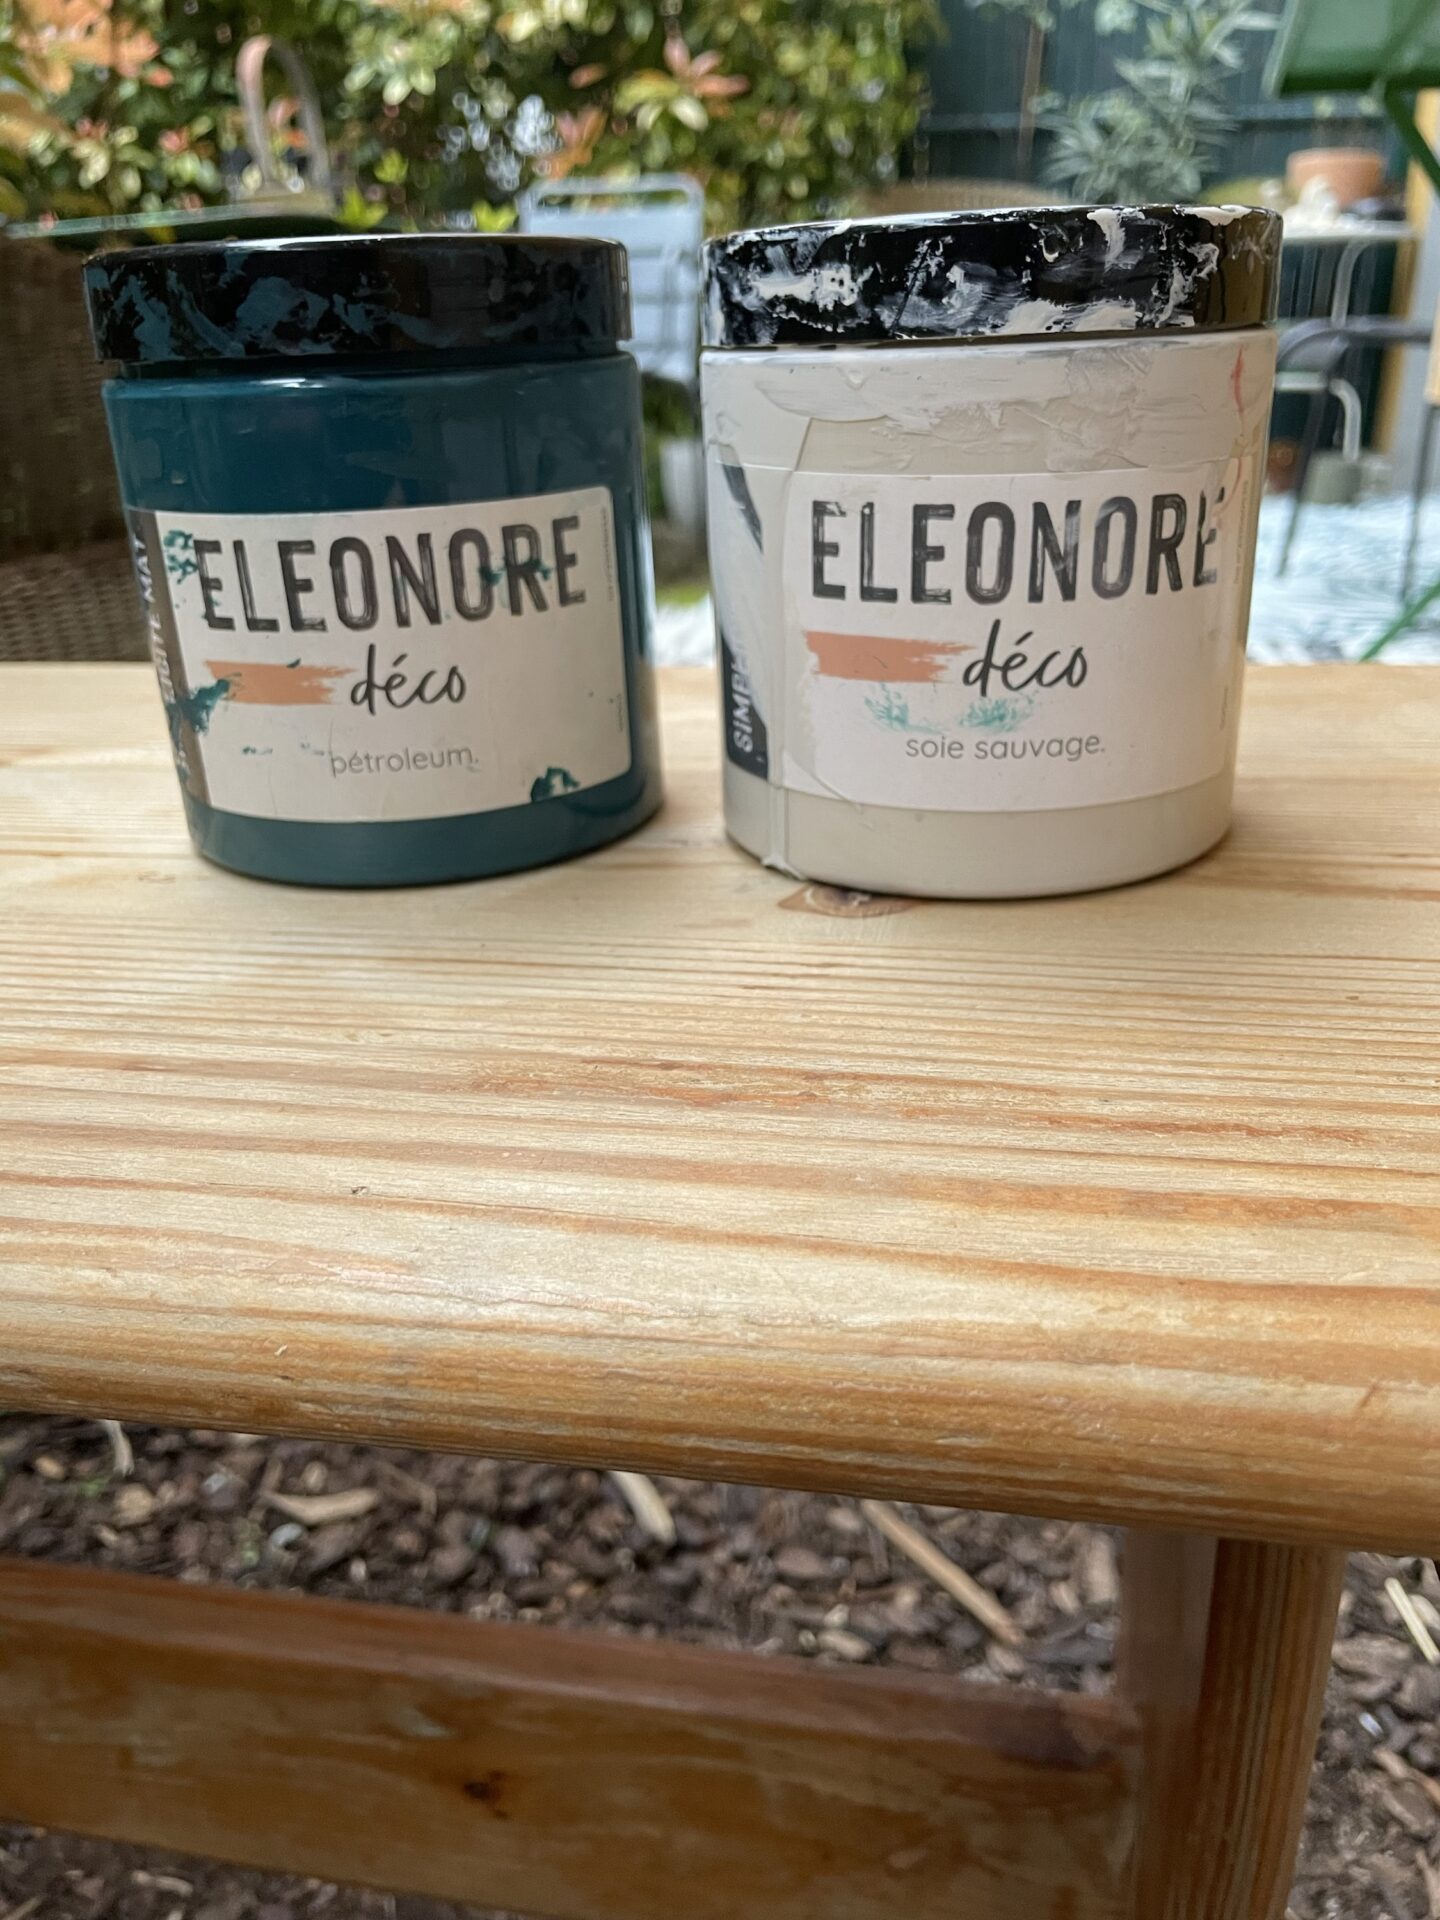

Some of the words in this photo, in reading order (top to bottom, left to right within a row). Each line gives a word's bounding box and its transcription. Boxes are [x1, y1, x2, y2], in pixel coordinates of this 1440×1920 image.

[194, 515, 586, 632] ELEONORE
[811, 493, 1225, 605] ELEONORE
[350, 643, 466, 716] déco
[962, 619, 1088, 697] déco
[905, 735, 964, 758] soie
[974, 734, 1105, 764] sauvage.
